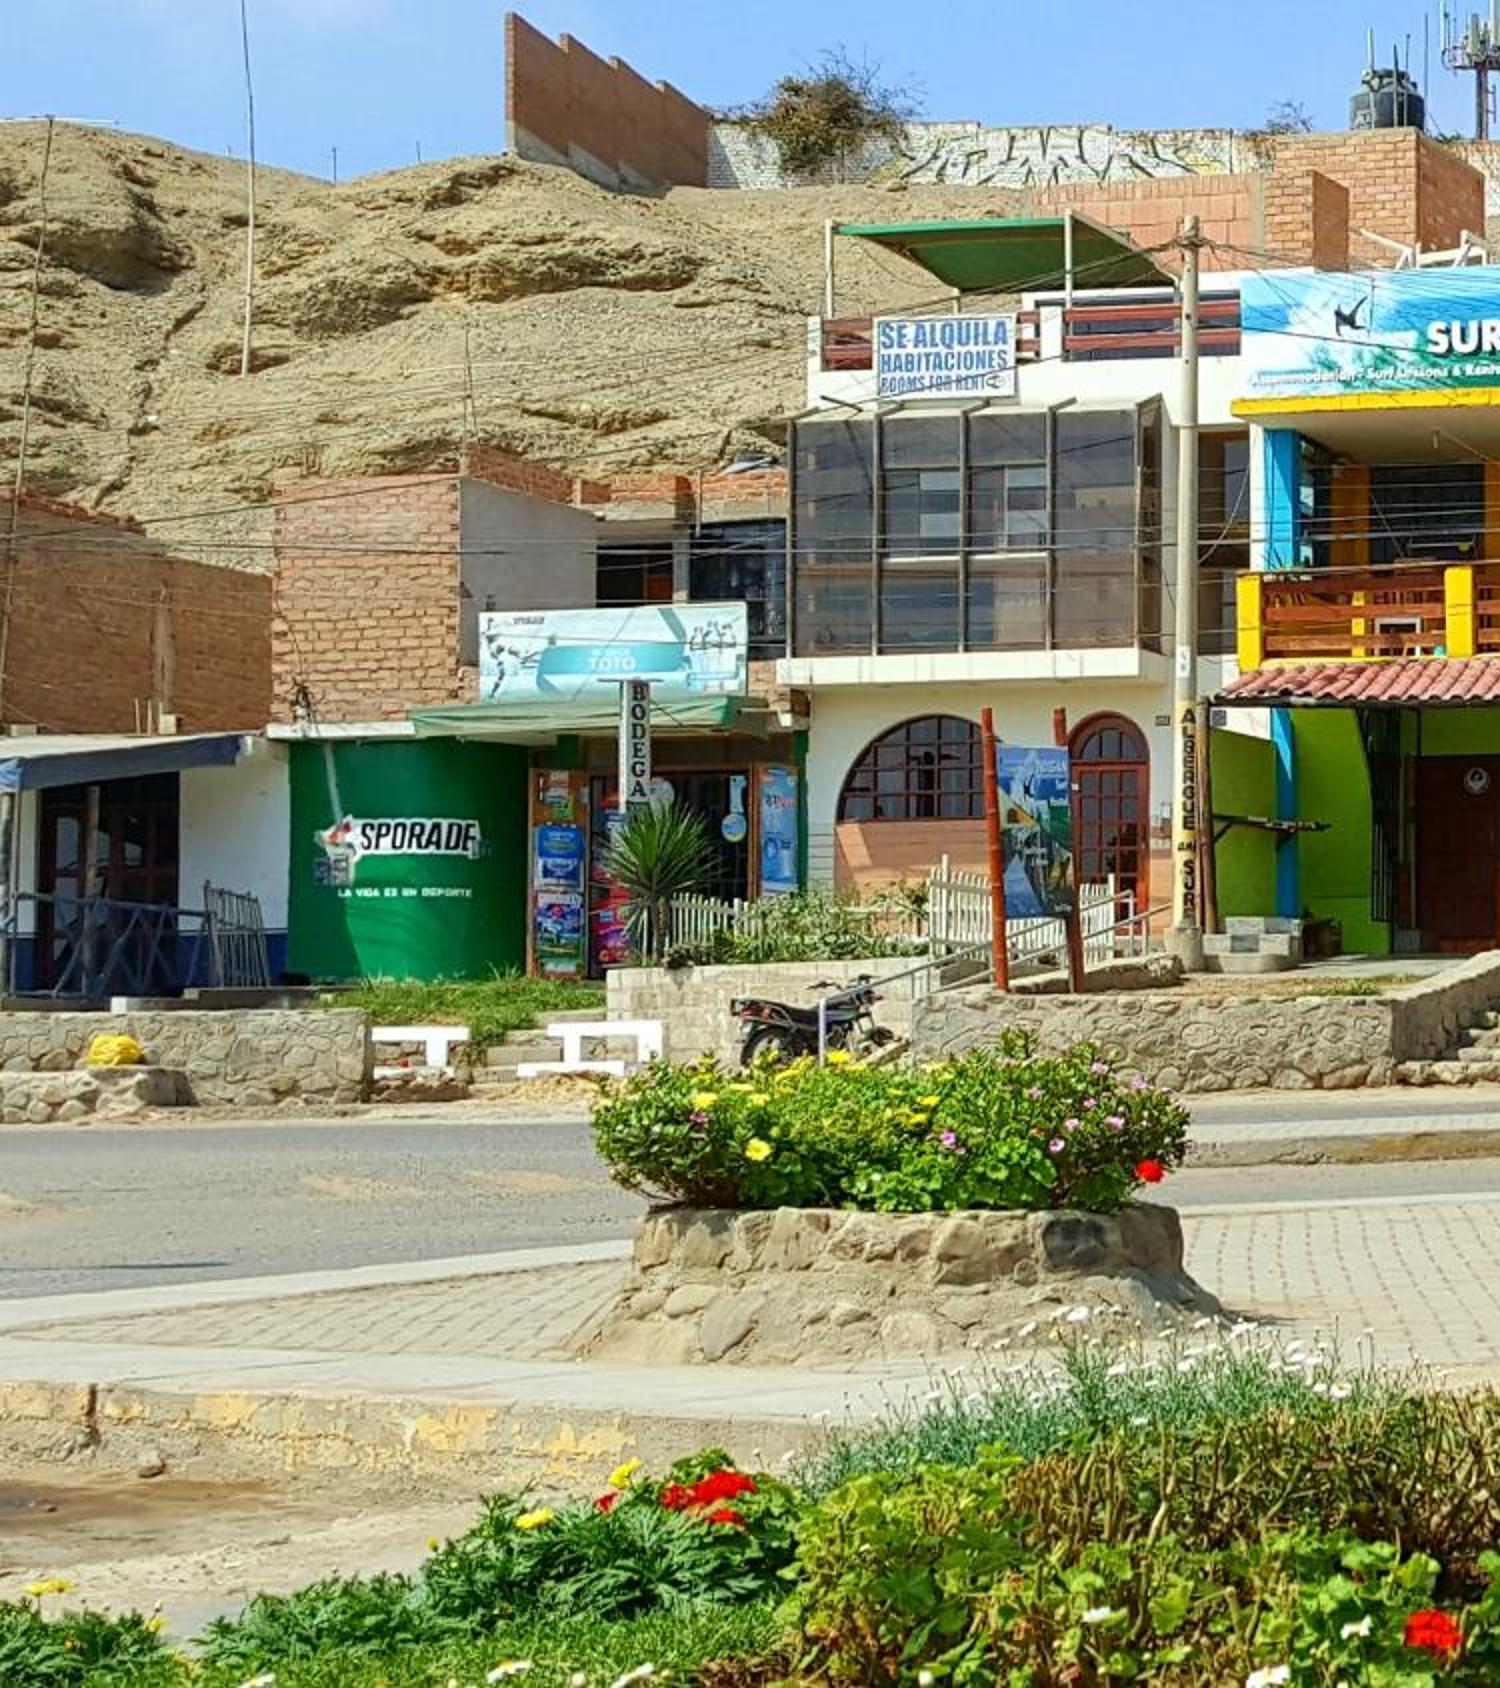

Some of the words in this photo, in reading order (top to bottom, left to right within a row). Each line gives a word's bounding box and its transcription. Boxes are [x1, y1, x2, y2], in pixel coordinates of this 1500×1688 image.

[881, 321, 907, 349] SE
[914, 320, 1009, 350] ALQUILA
[881, 350, 1009, 374] HABITACIONES
[881, 375, 925, 393] ROOMS
[929, 375, 953, 392] FOR
[956, 374, 985, 391] RENT
[589, 657, 638, 671] TOTO
[630, 683, 647, 797] BODEGA
[1181, 708, 1197, 831] ALBERGUE
[361, 821, 478, 851] SPORADE
[338, 887, 352, 898] LA
[356, 887, 380, 898] VIDA
